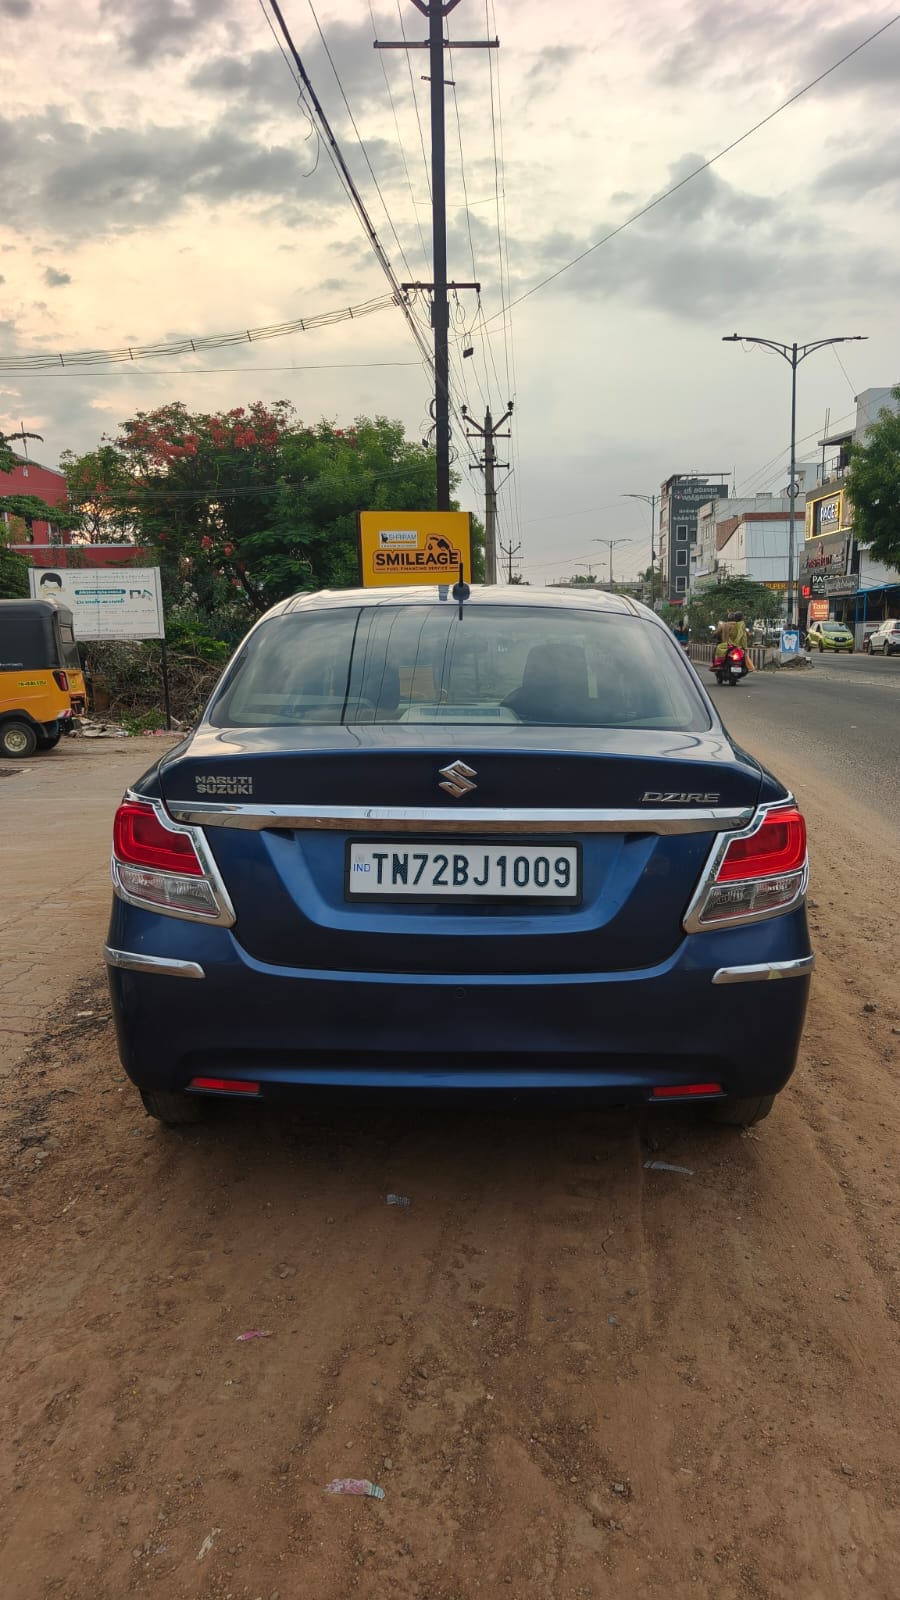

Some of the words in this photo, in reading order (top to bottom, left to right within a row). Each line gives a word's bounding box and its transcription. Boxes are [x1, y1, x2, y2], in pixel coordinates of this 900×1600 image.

[375, 552, 459, 566] SMILEAGE
[195, 775, 252, 784] MARUTI
[196, 784, 253, 794] SUZUKI
[640, 792, 720, 803] DZIRE
[353, 863, 371, 873] IND
[372, 853, 571, 888] TN72BJ1009
